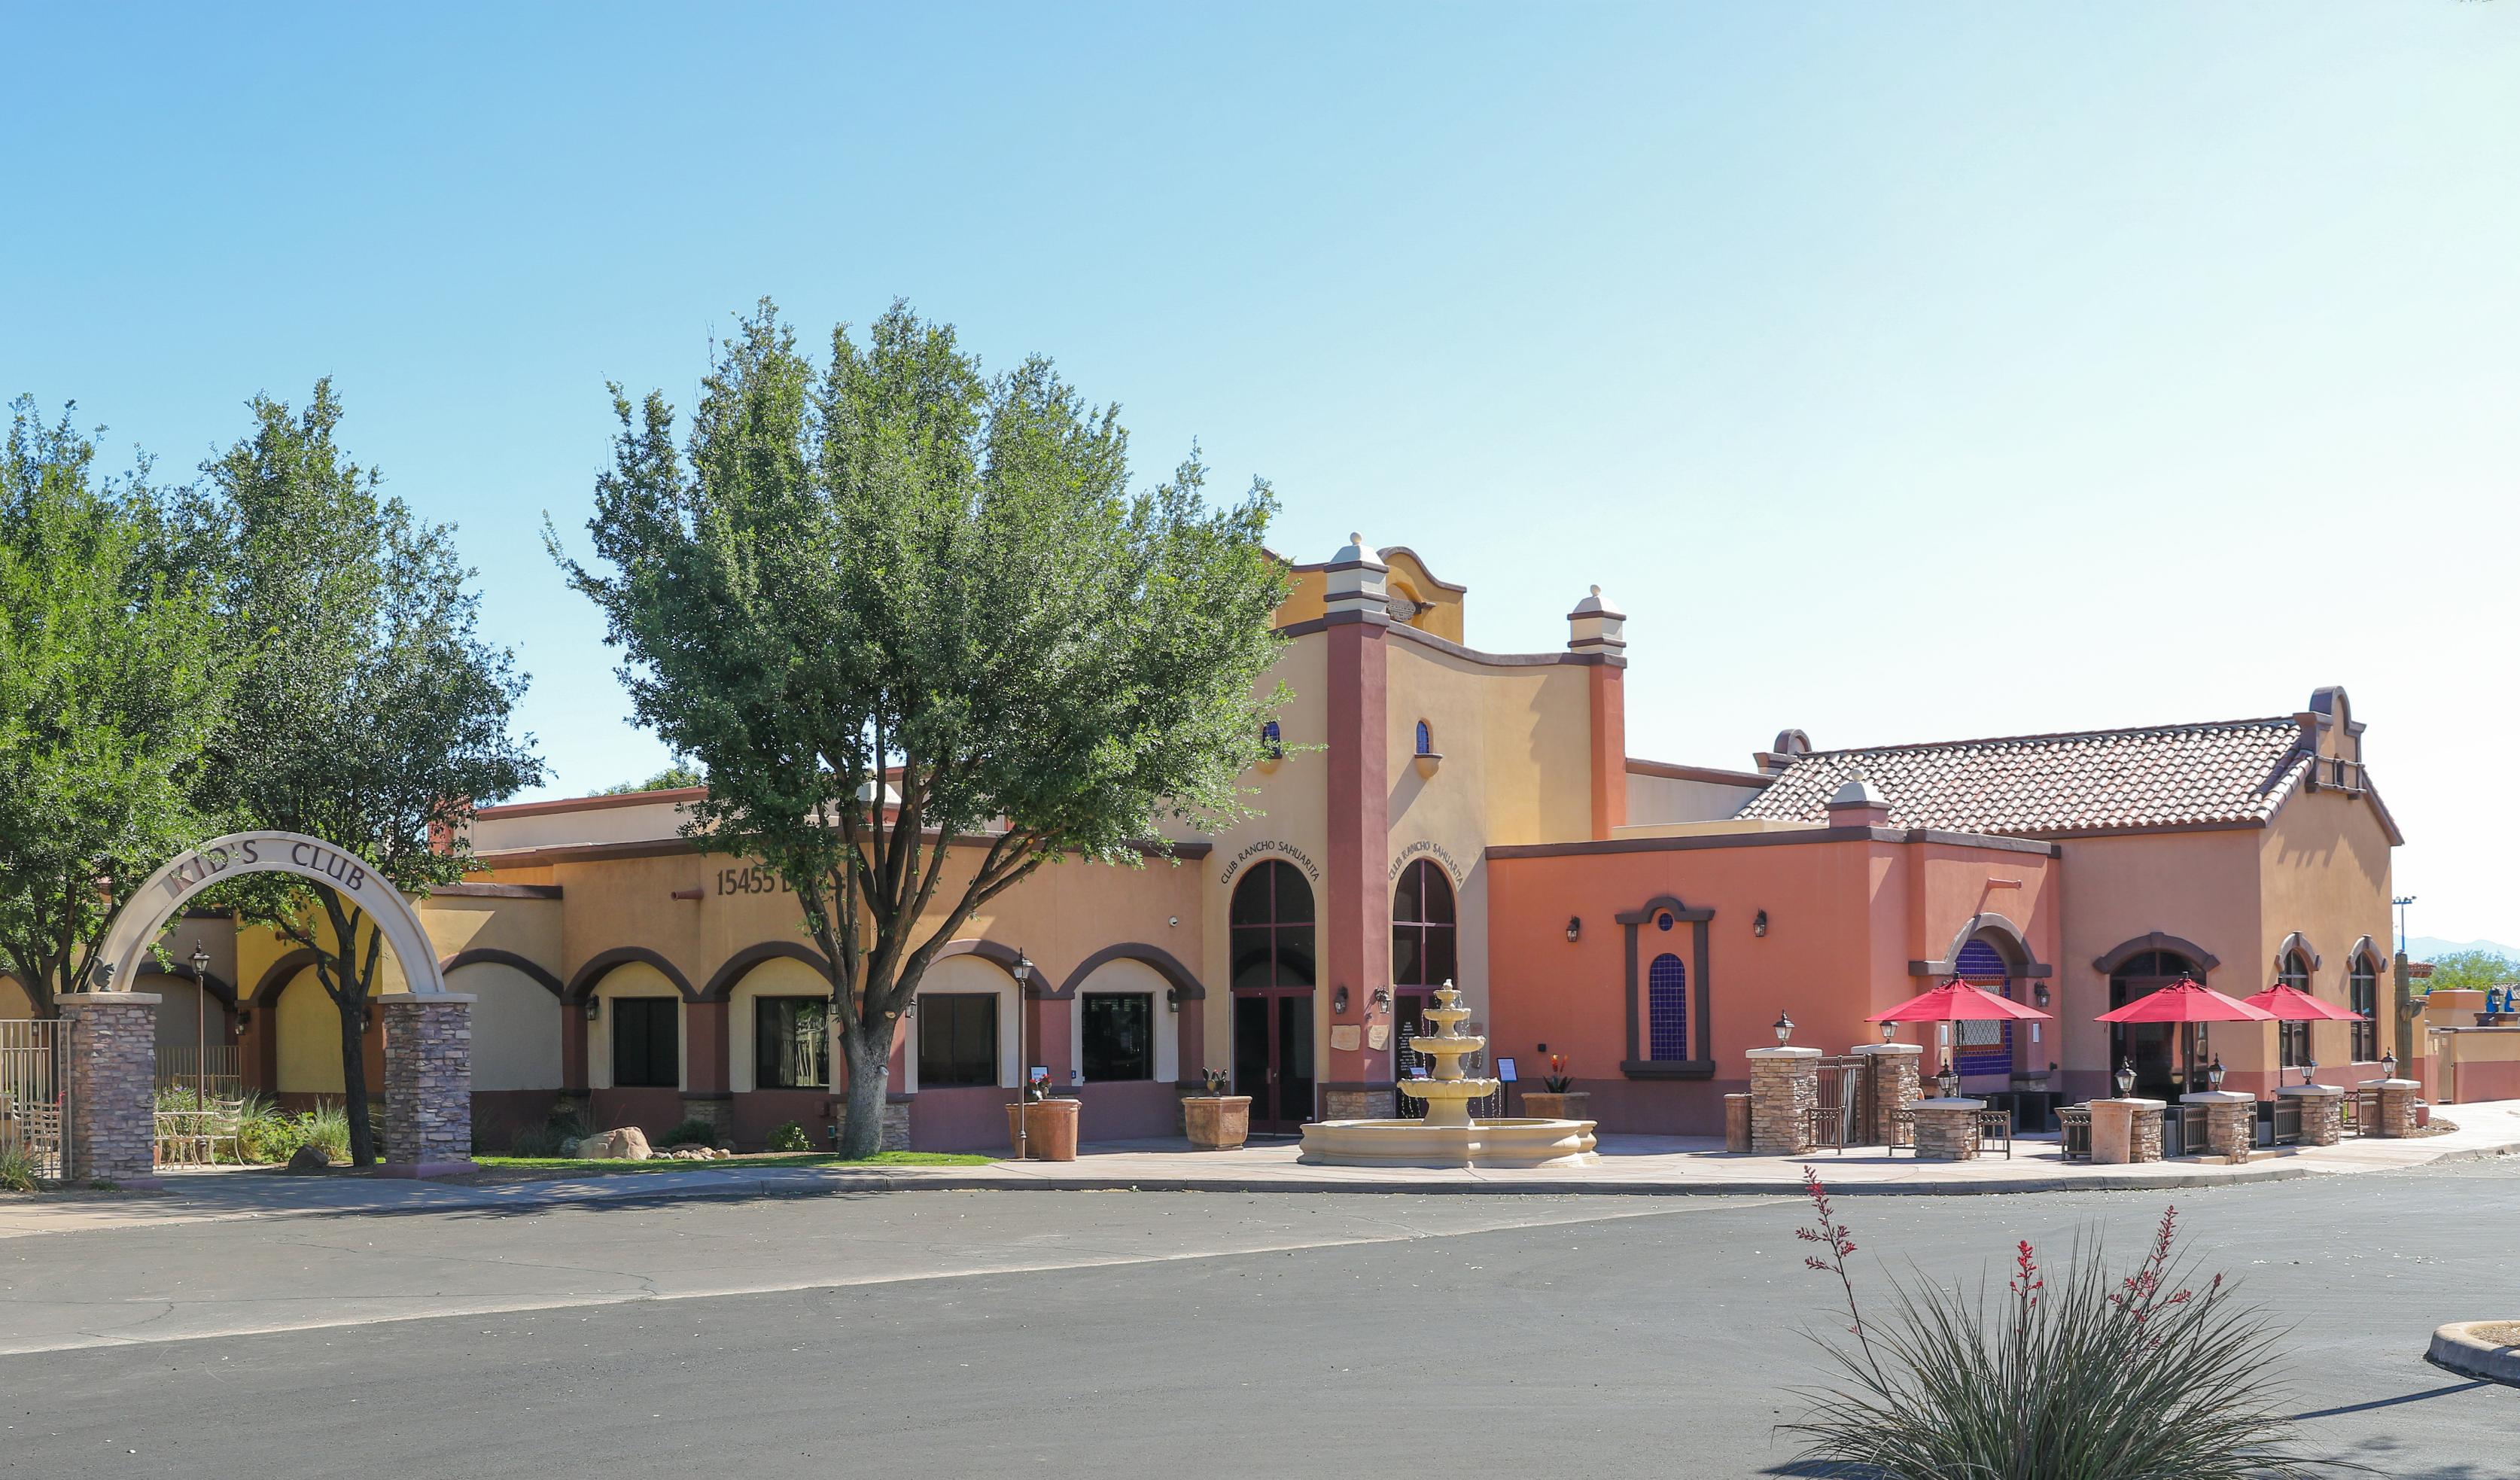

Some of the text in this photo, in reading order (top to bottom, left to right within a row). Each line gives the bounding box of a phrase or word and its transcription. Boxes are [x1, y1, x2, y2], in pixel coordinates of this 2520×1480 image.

[169, 839, 365, 892] KID'S CLUB
[717, 866, 775, 896] 15455
[1221, 840, 1319, 884] CLUB RANCHO SAHUARITA
[1388, 841, 1463, 886] CLUB RANCHO SAHUARITA
